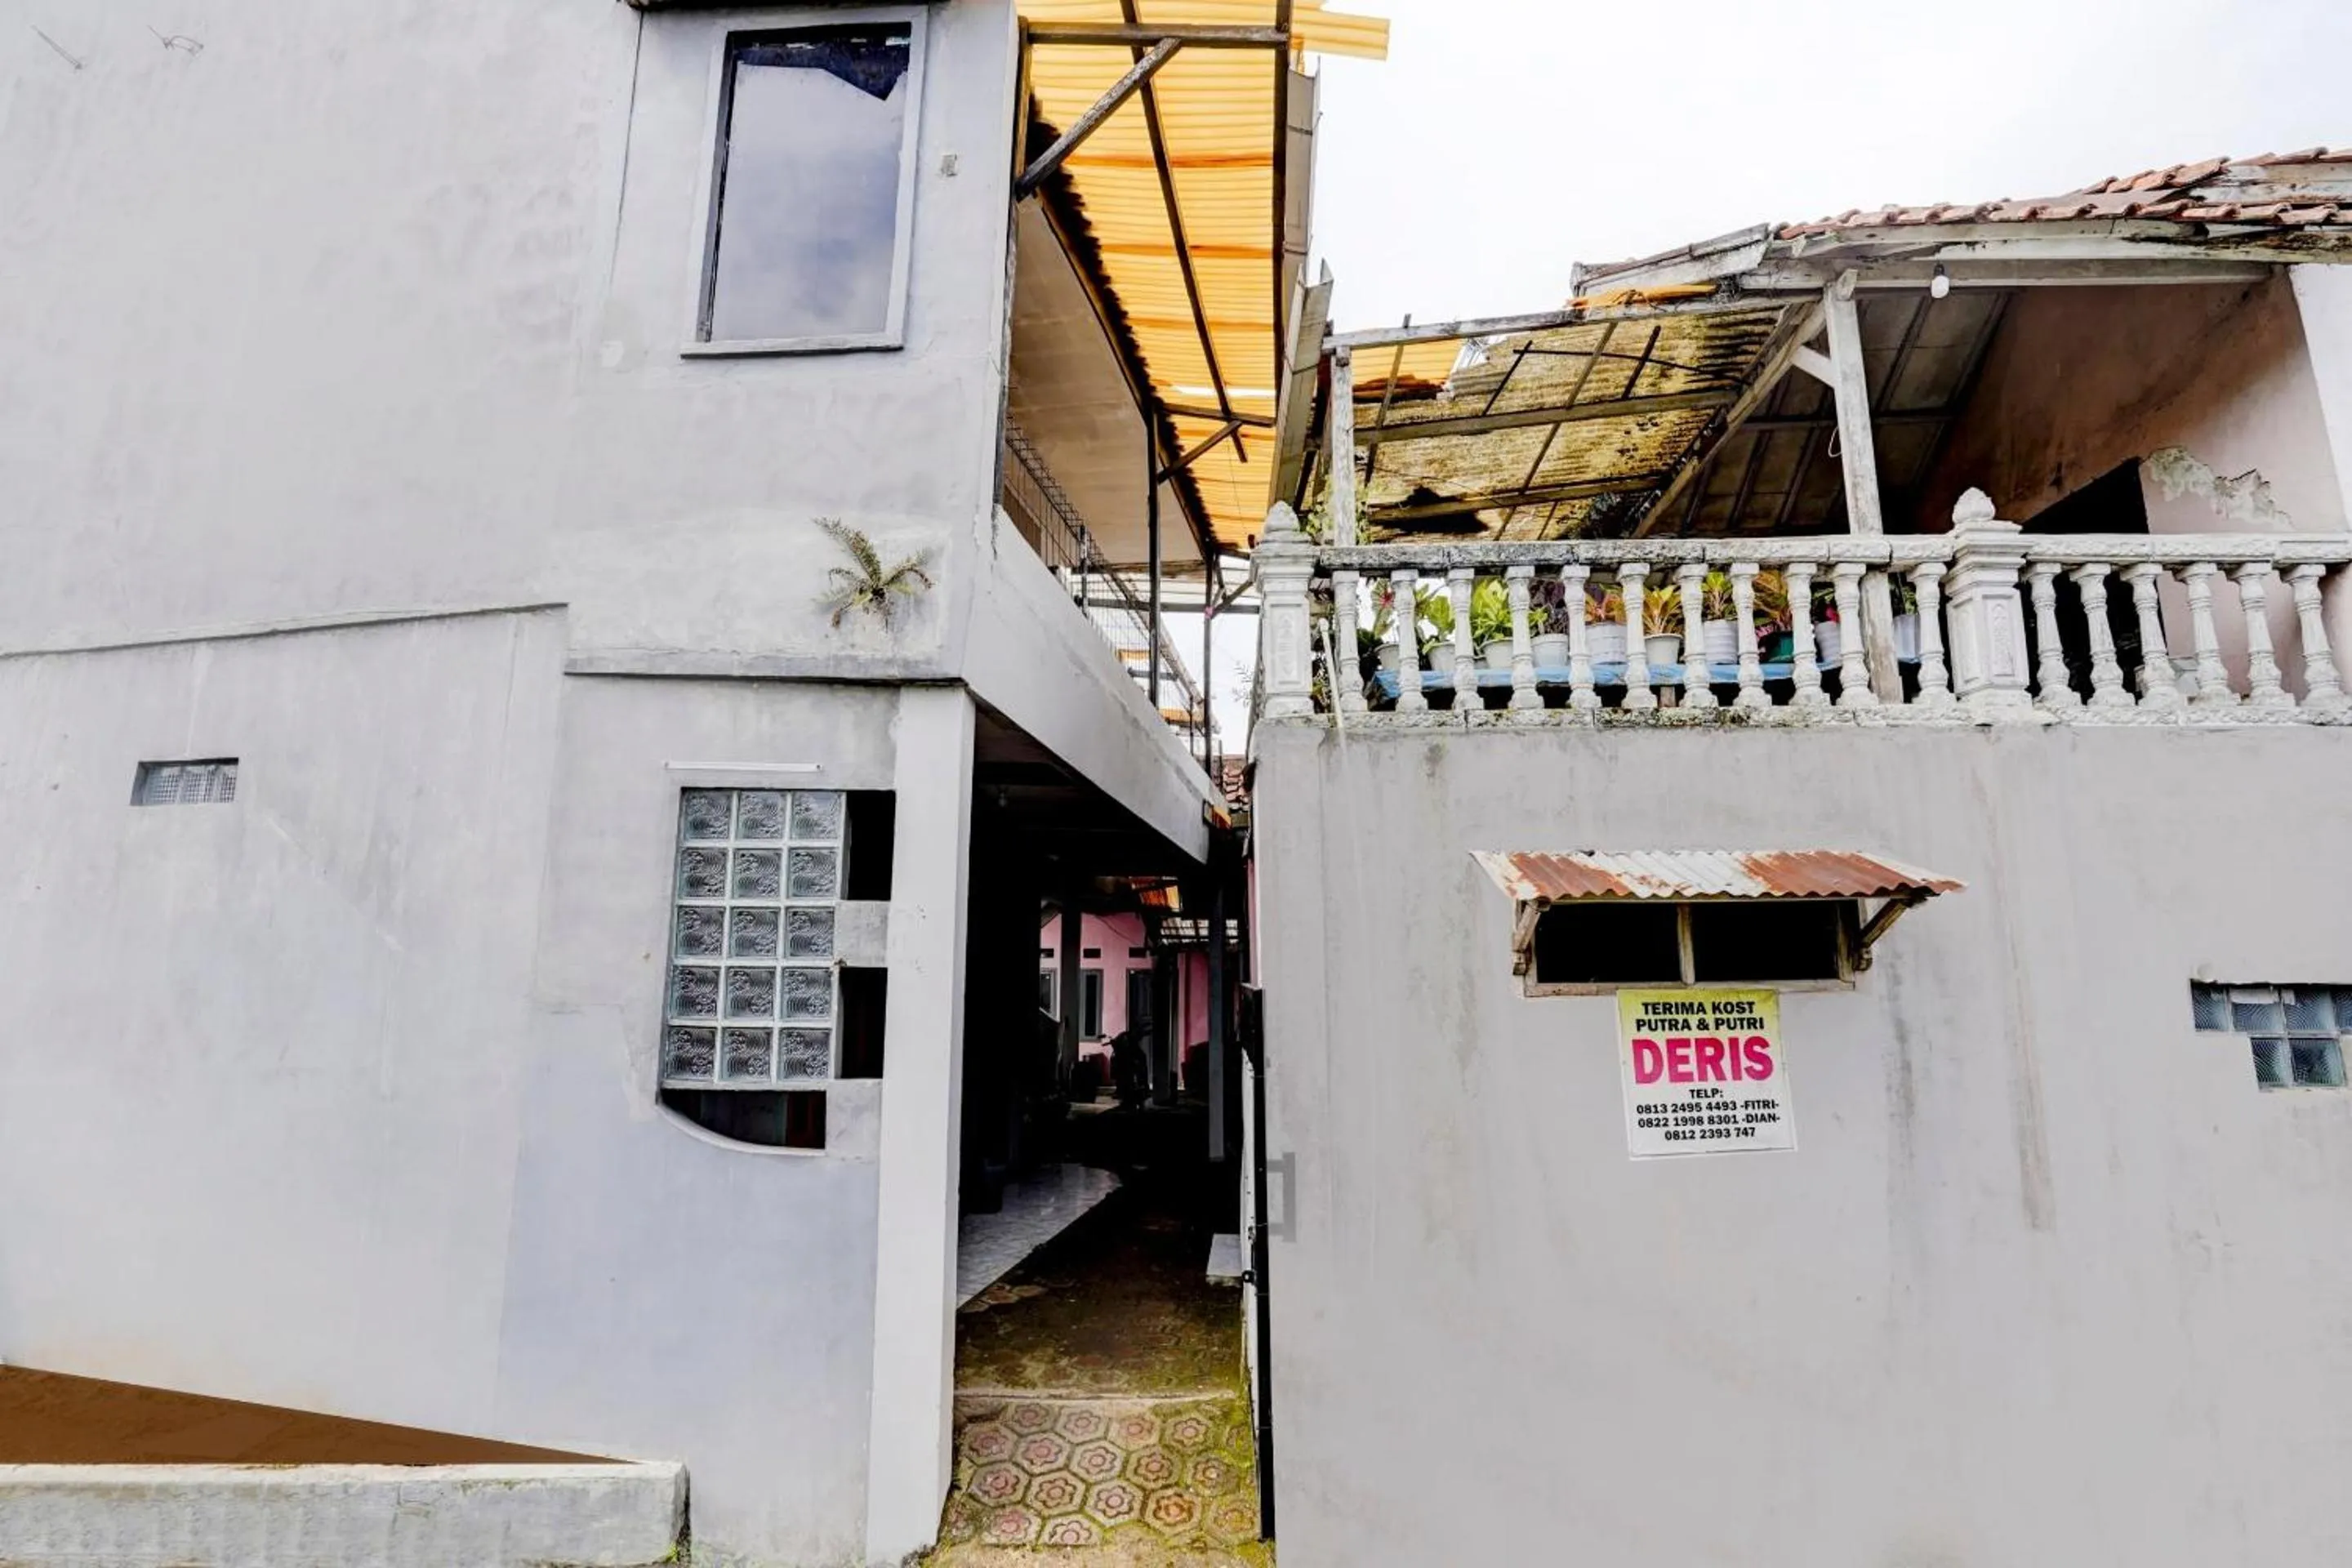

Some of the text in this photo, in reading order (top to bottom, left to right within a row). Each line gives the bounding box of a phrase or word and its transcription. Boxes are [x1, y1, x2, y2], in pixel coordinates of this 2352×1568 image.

[1642, 1001, 1755, 1015] TERIMA KOST
[1636, 1018, 1764, 1032] PUTRA & PUTRI
[1632, 1036, 1773, 1085] DERIS
[1689, 1089, 1723, 1099] TELP:
[1637, 1099, 1779, 1114] 0813 2495 4493 -FITRI-
[1638, 1113, 1780, 1128] 0822 1998 8301 -DIAN-
[1664, 1127, 1756, 1140] 0812 2393 747
